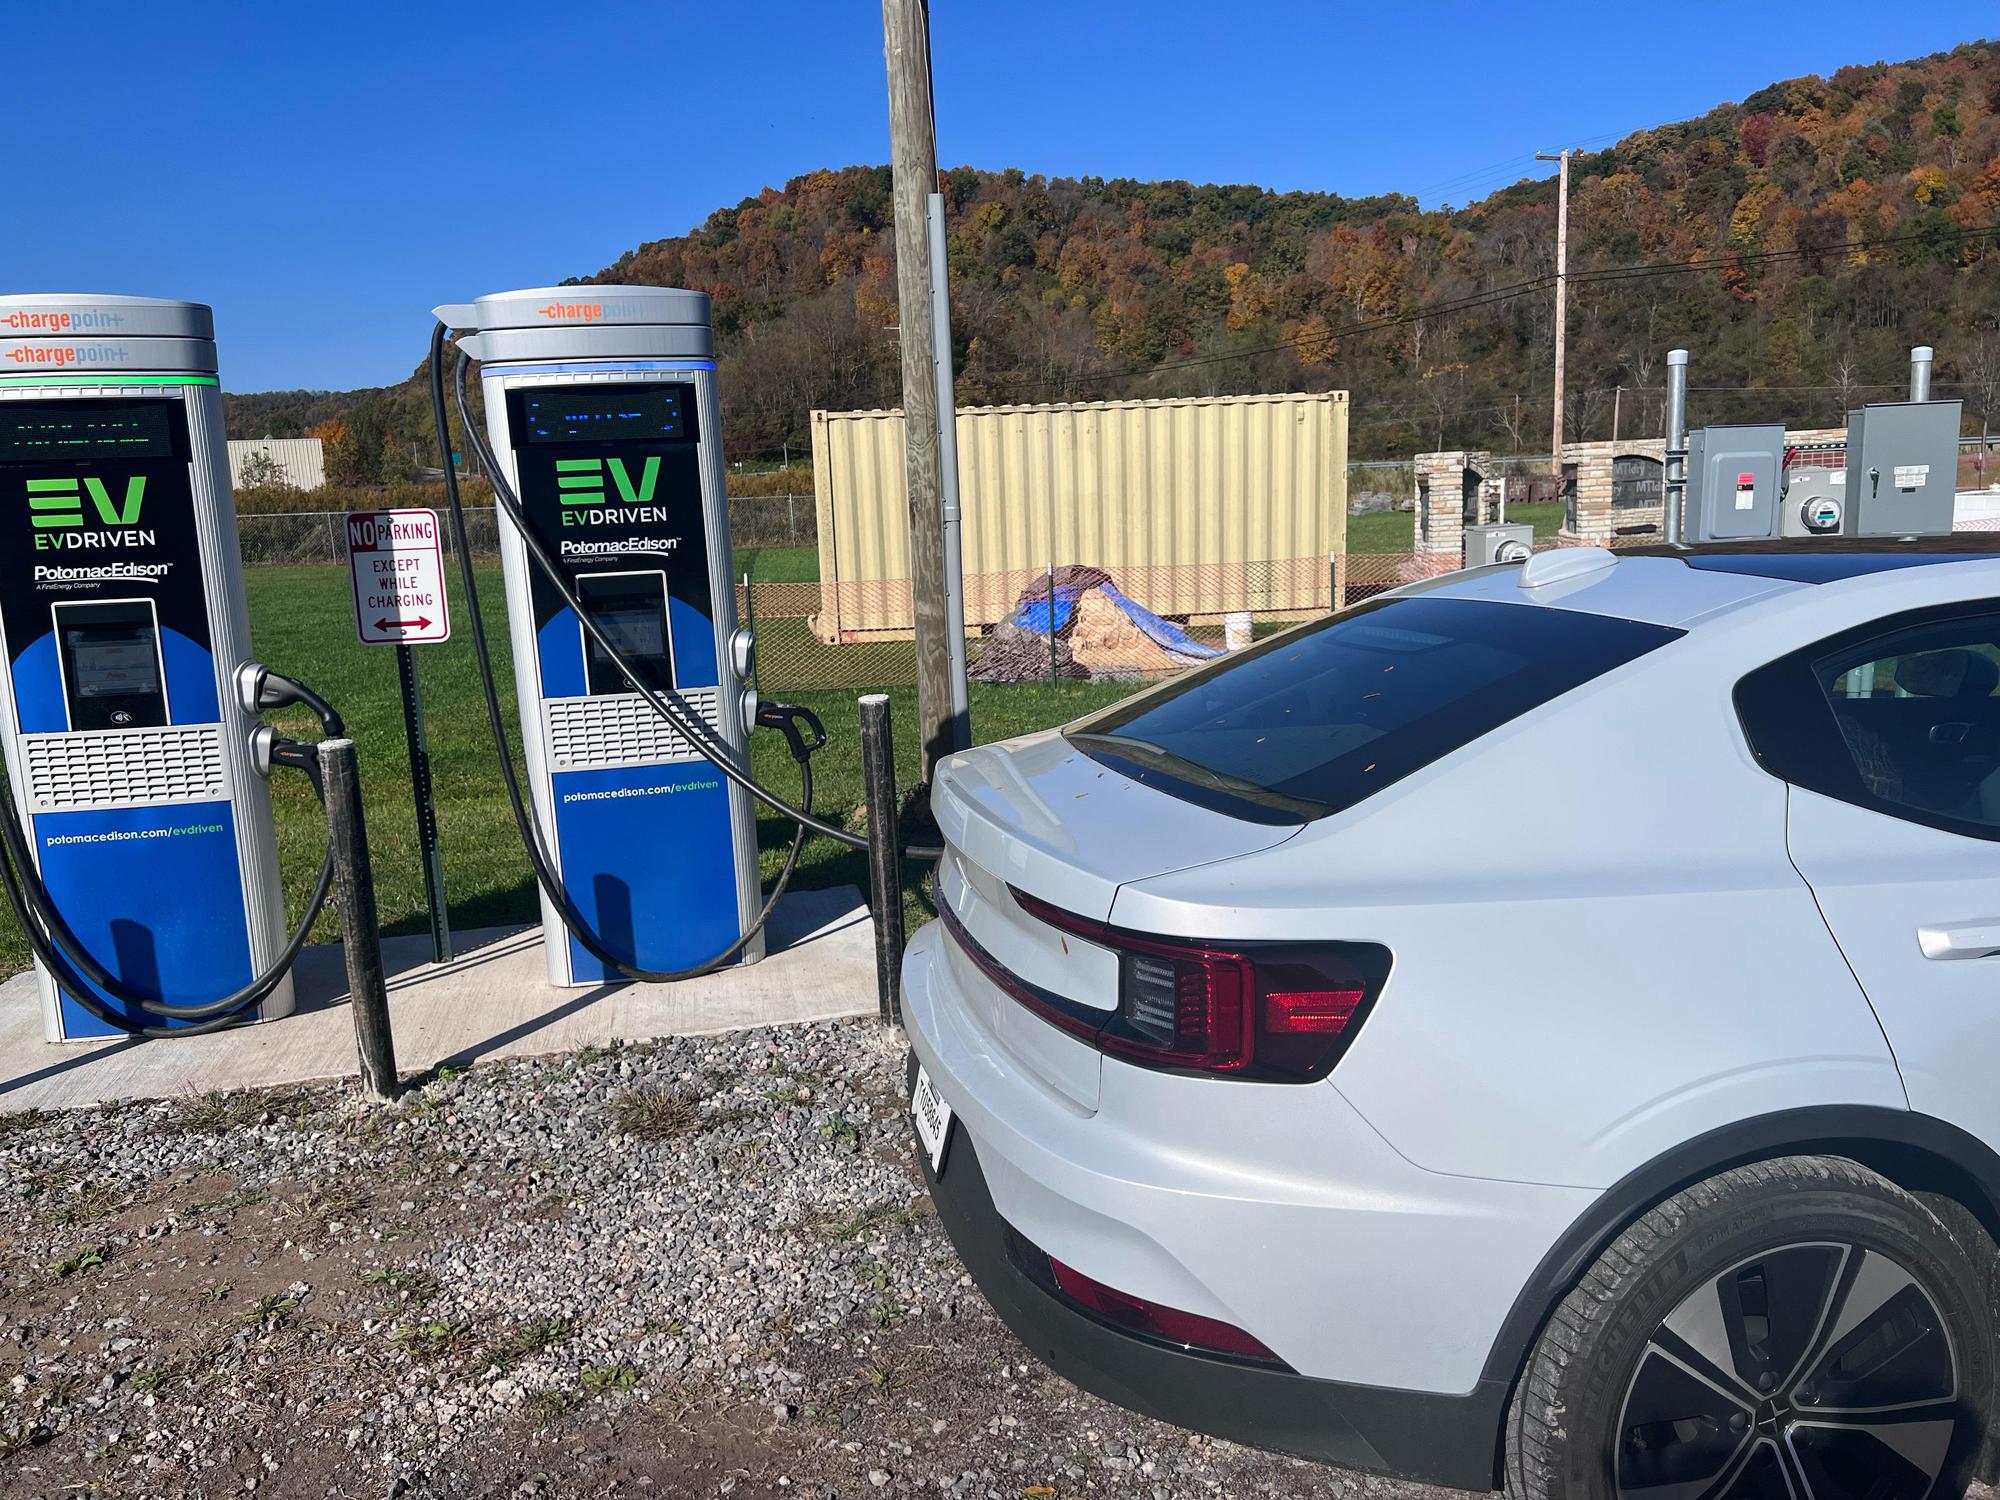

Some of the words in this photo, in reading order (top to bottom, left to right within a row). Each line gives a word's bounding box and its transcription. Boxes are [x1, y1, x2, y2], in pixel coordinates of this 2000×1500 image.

[1, 310, 124, 331] chargepoint
[6, 345, 128, 366] chargepoint
[556, 456, 662, 505] EV
[26, 476, 147, 528] EV
[561, 507, 667, 526] EVDRIVEN
[34, 530, 156, 550] EVDRIVEN
[350, 521, 375, 546] NO
[377, 522, 433, 541] PARKING
[560, 536, 677, 554] PotomacEdison
[372, 558, 421, 573] EXCEPT
[594, 555, 619, 563] Company
[34, 562, 168, 581] PotomacEdison
[42, 583, 73, 591] FirstEnergy
[73, 581, 101, 590] Company
[378, 576, 418, 590] WHILE
[367, 593, 433, 609] CHARGING
[563, 779, 719, 803] potomacedison.com/evdriven
[46, 823, 224, 847] potomacedison.com/evdriven
